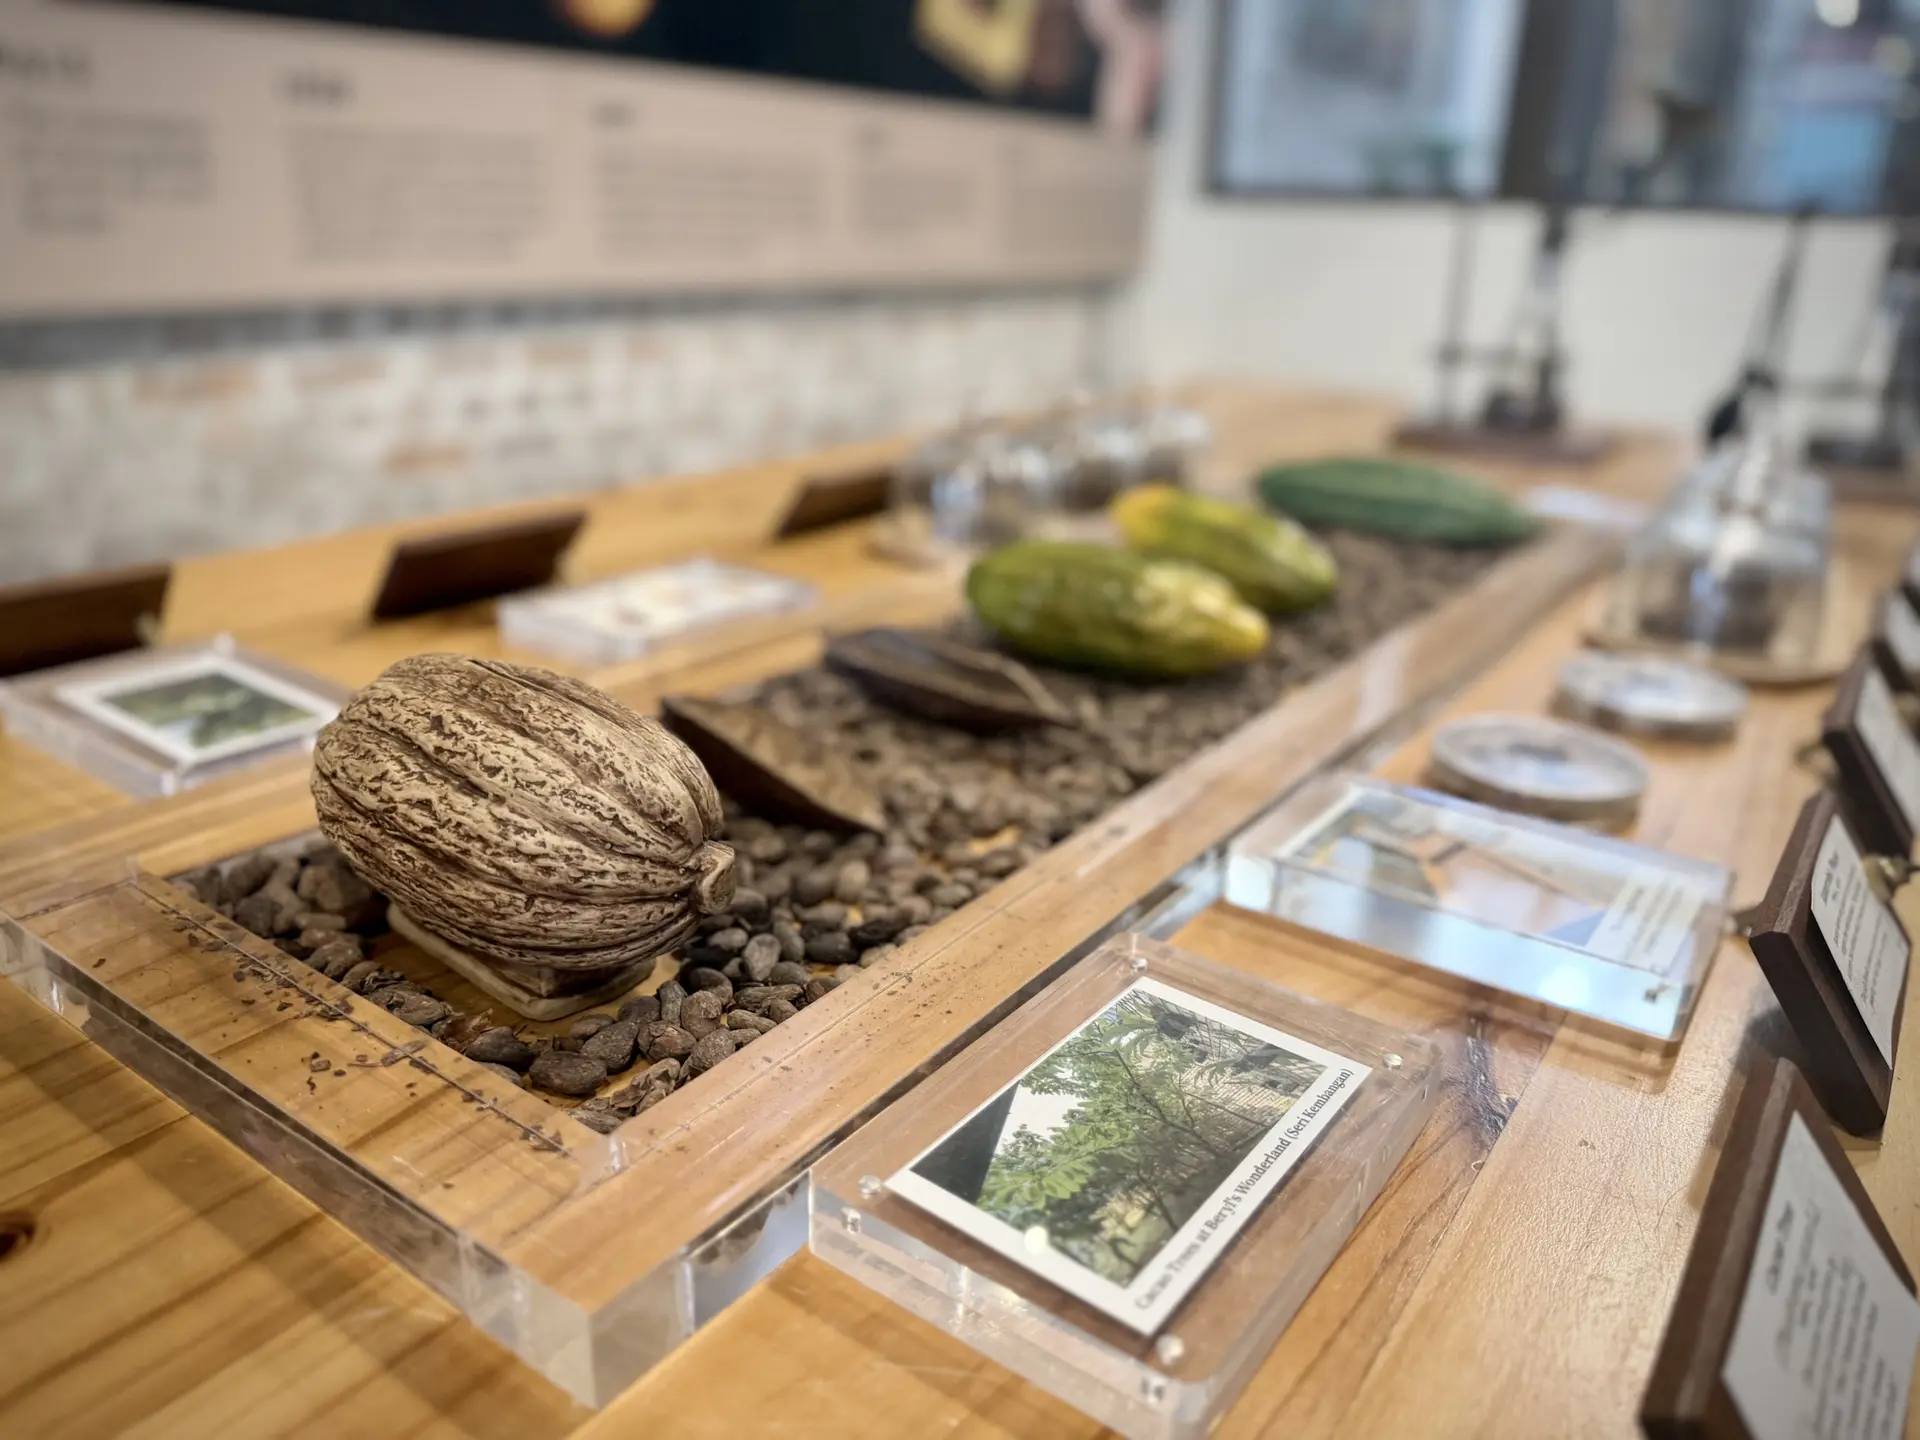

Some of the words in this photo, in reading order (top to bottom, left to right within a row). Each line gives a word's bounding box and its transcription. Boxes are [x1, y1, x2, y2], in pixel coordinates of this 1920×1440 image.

[1197, 1226, 1211, 1244] at
[1204, 1193, 1243, 1232] Beryl's
[1235, 1137, 1292, 1198] Wonderland
[1284, 1115, 1309, 1141] (Seri
[1304, 1068, 1355, 1122] Kembangan)
